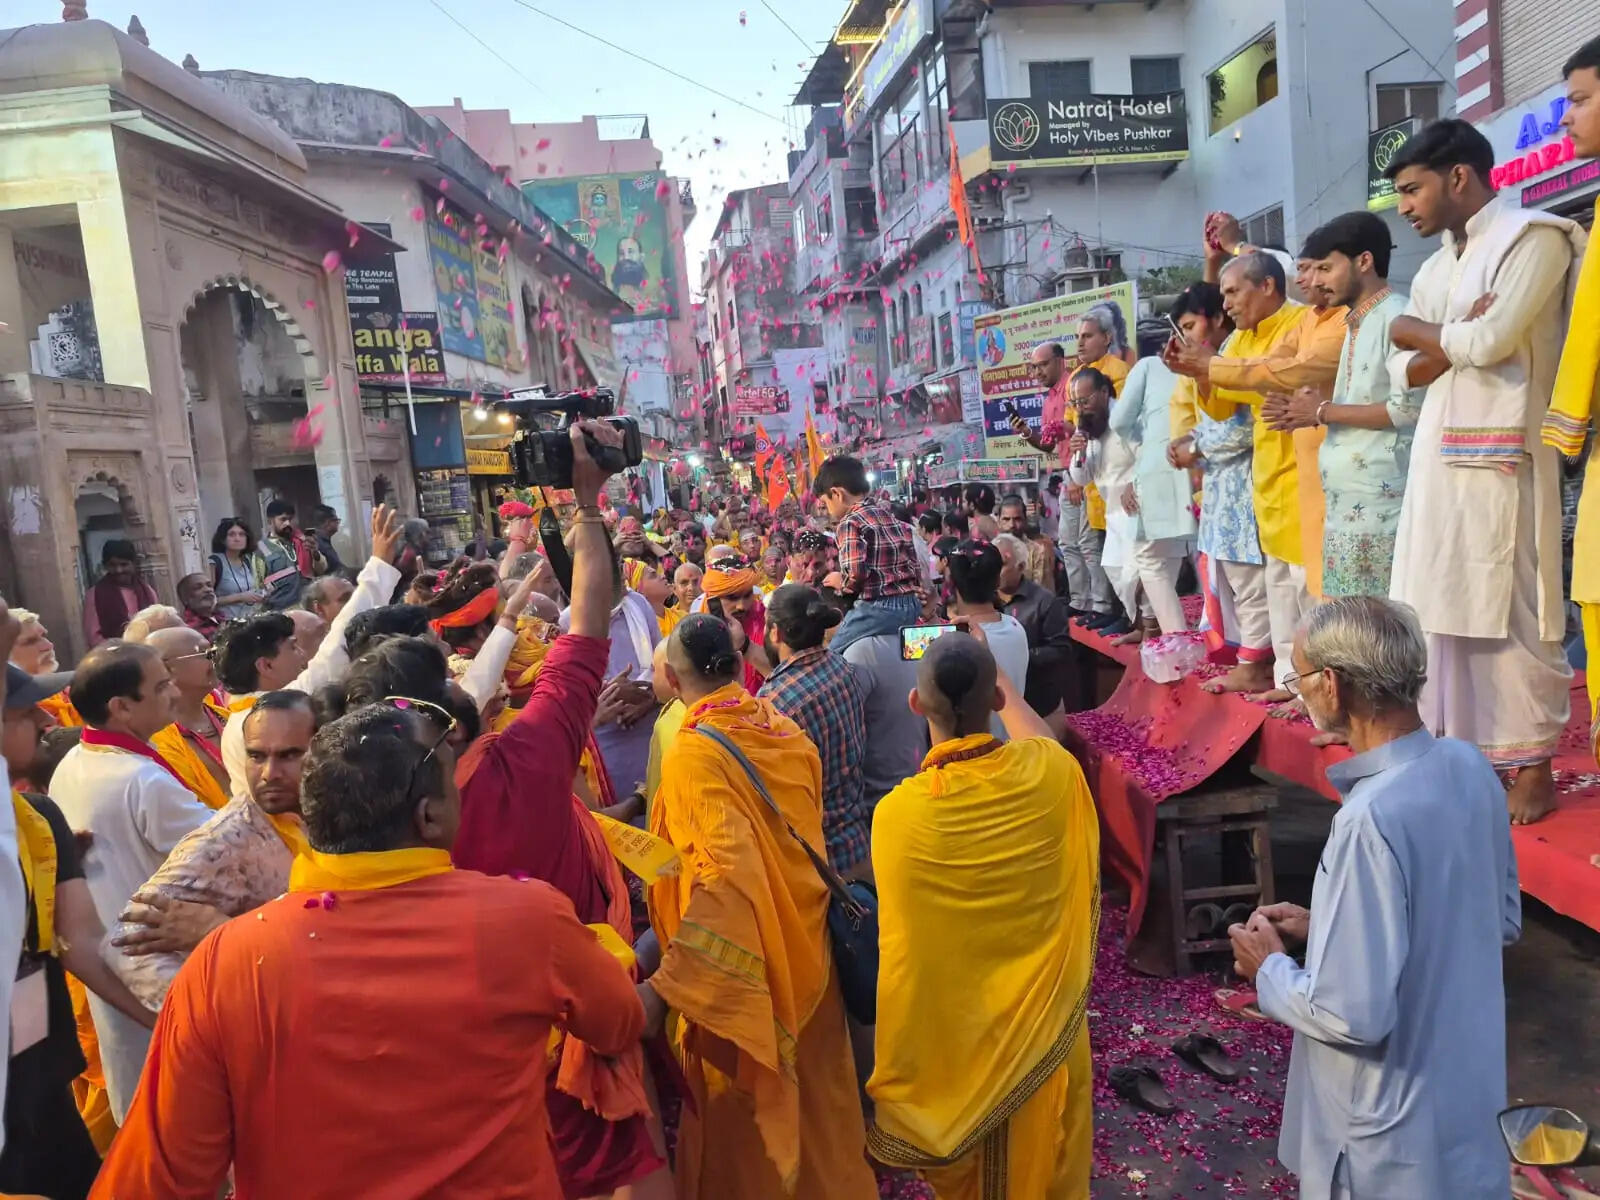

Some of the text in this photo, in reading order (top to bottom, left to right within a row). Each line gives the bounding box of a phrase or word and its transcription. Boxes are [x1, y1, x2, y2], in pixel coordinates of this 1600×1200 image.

[1048, 95, 1172, 121] Natraj Hotel
[1049, 126, 1173, 146] Holy Vibes Pushkar
[1530, 175, 1568, 200] GENERAL
[354, 328, 432, 352] anga
[1014, 341, 1030, 351] 2000
[355, 353, 439, 373] ffa Wala
